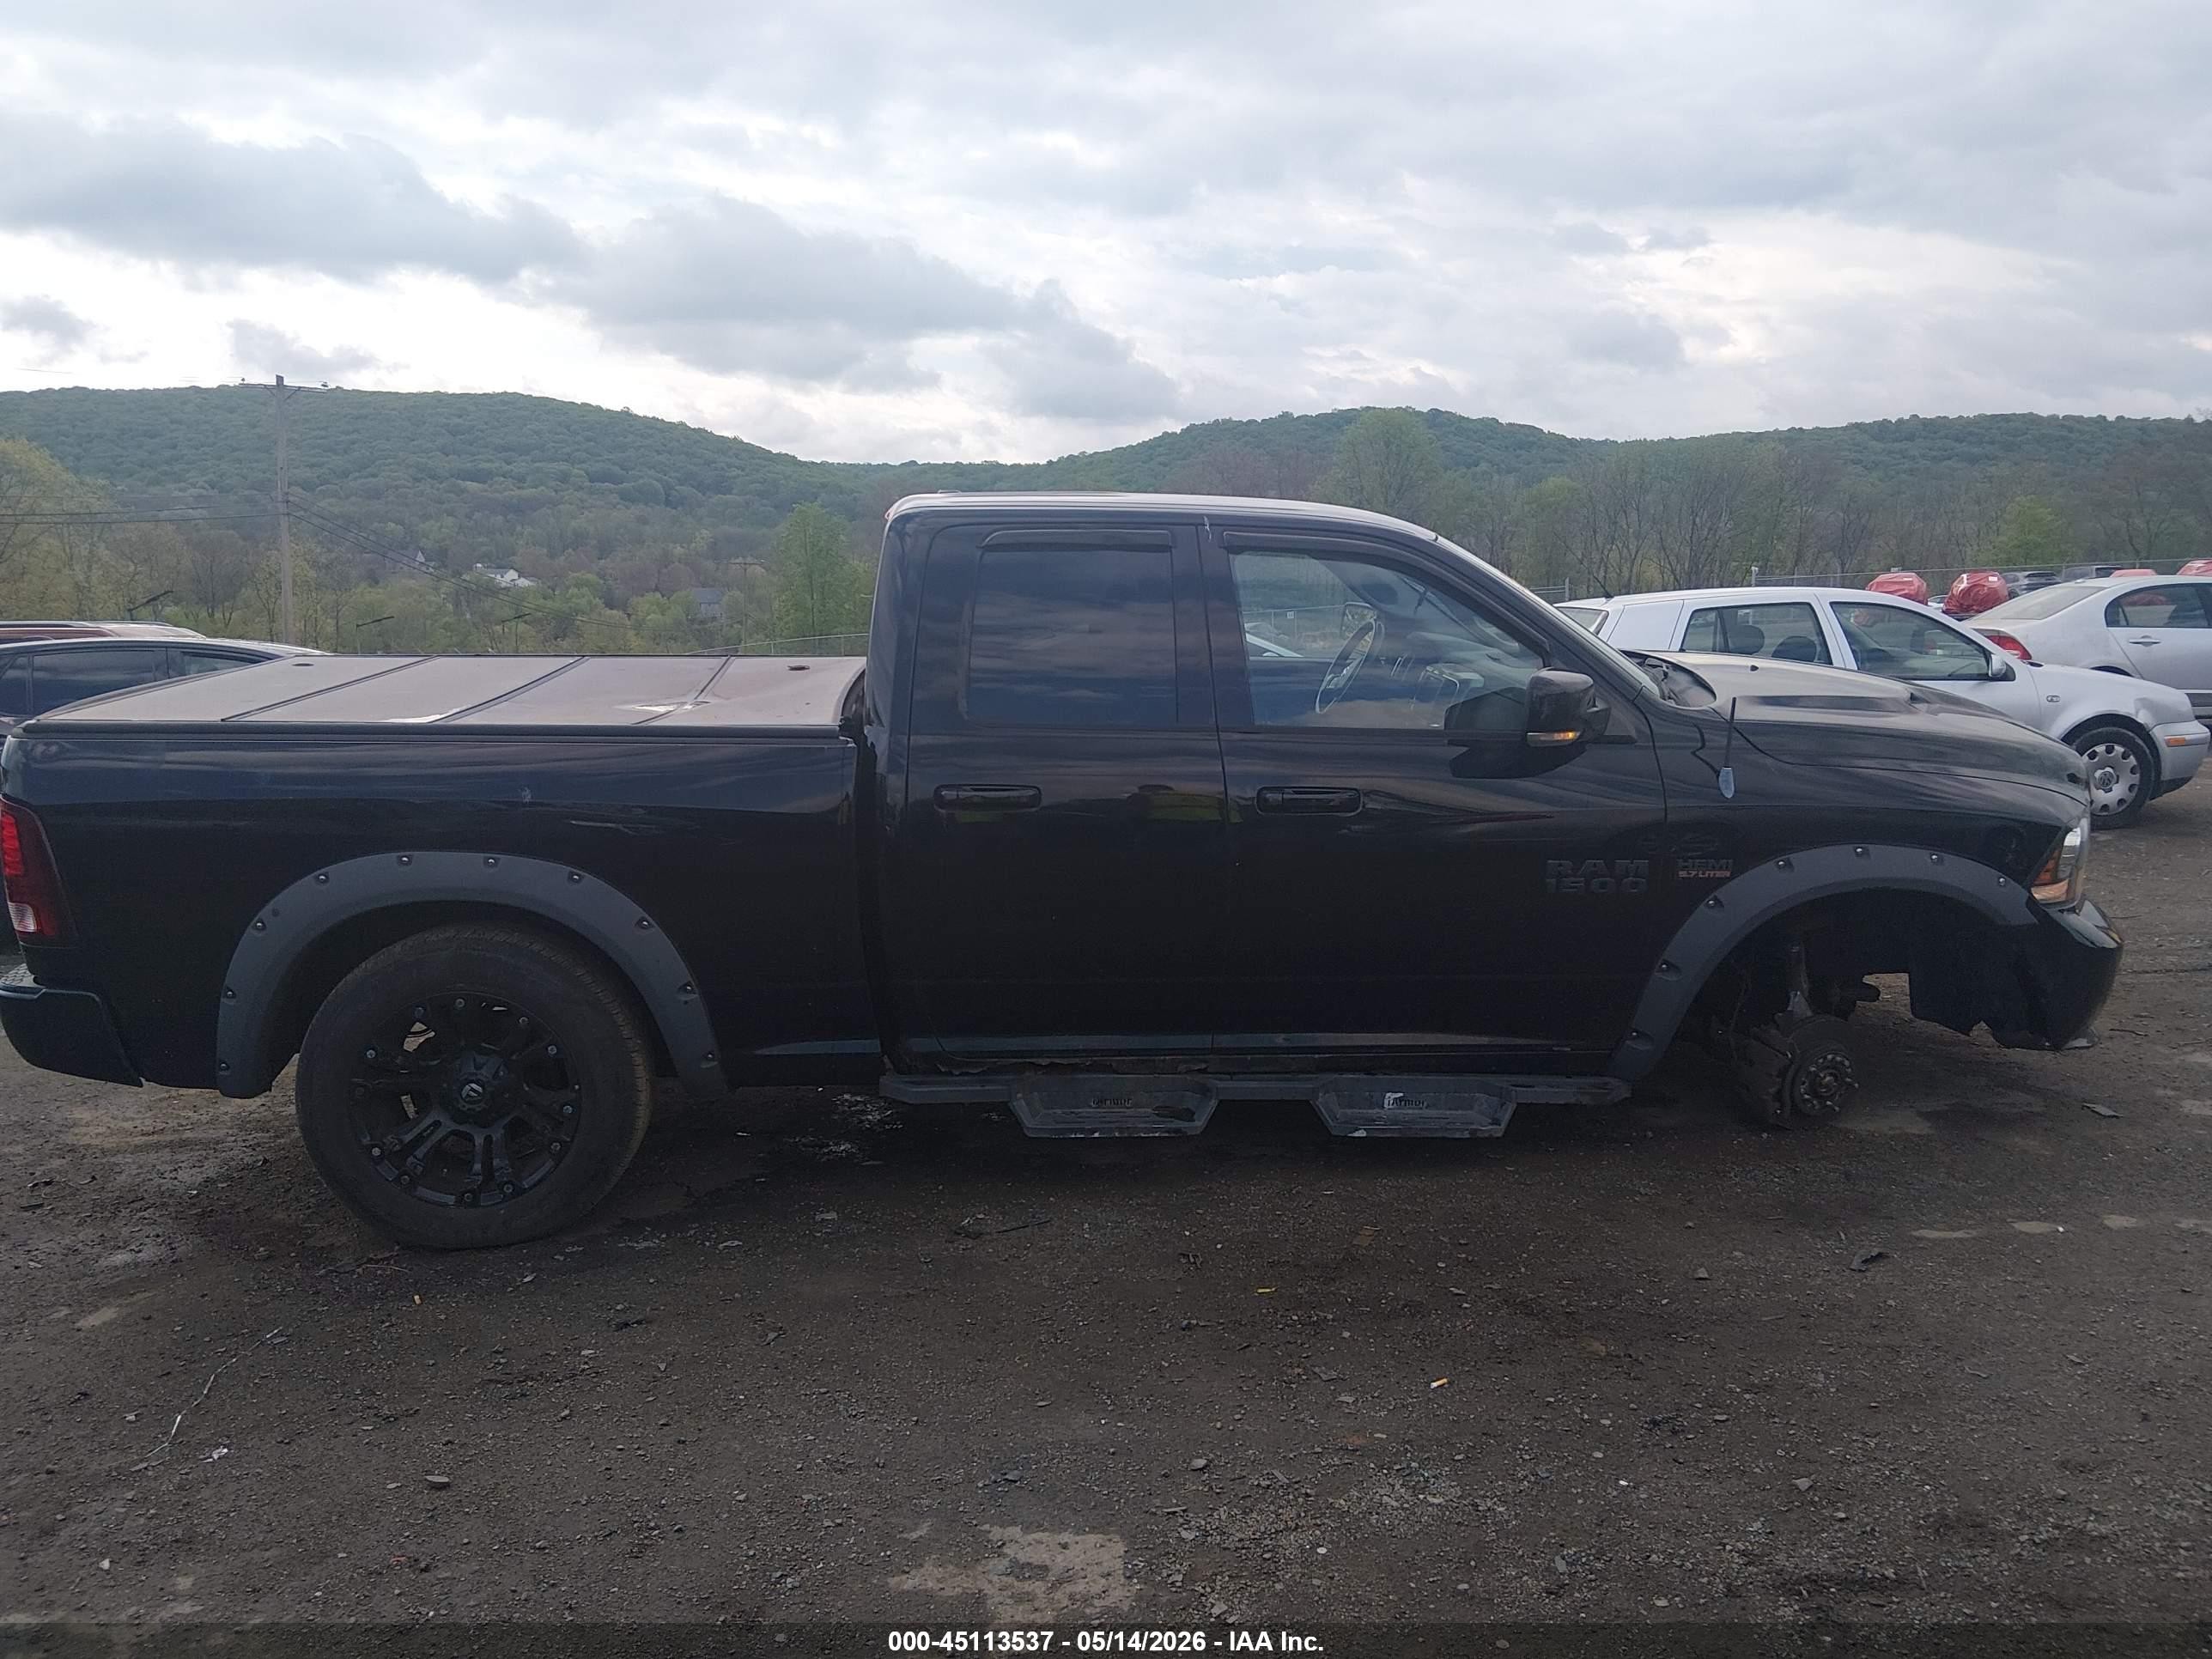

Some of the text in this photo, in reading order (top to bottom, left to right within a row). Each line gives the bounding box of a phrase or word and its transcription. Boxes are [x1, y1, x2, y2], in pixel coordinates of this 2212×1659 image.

[1546, 859, 1650, 878] RAM
[1675, 859, 1733, 869] HEMI
[1698, 870, 1731, 878] LITER
[1546, 878, 1649, 893] 1500
